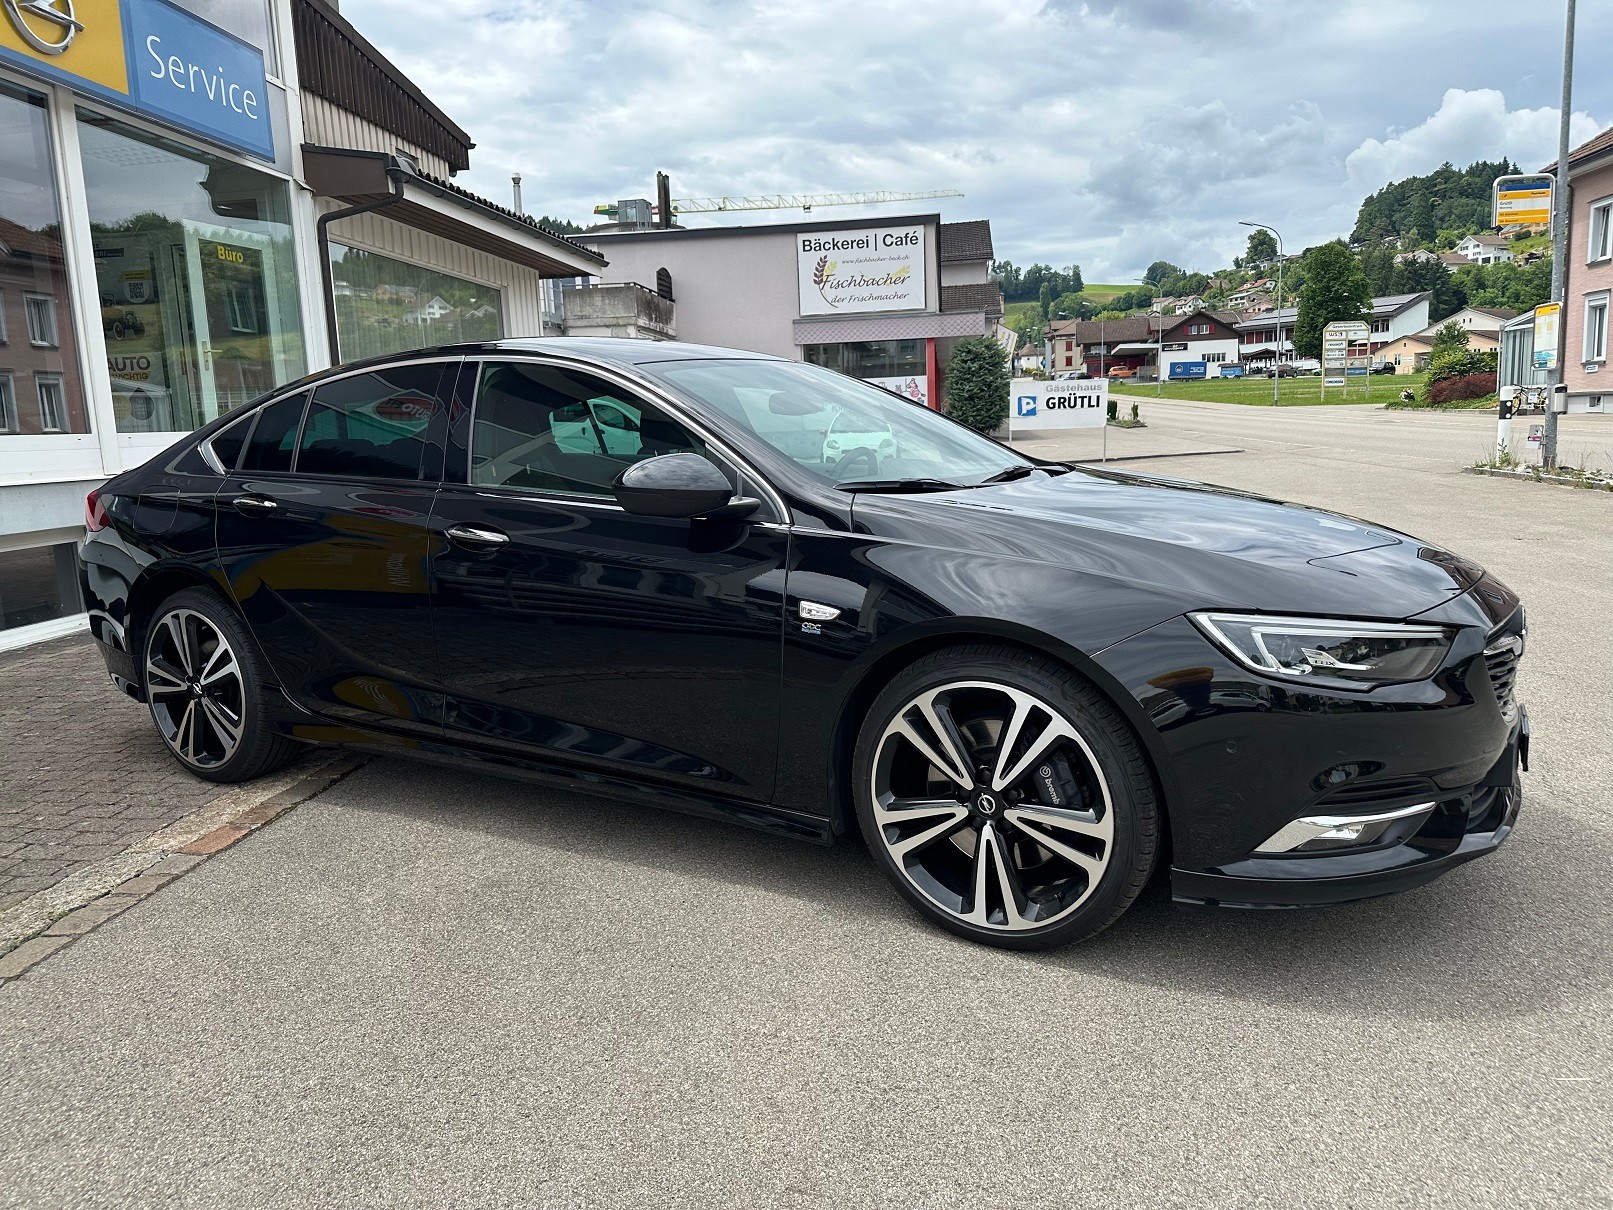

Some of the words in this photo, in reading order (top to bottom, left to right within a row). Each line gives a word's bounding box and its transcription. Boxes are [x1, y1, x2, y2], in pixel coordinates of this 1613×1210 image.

[146, 35, 258, 120] Service
[802, 235, 870, 252] Bäckerei
[882, 230, 919, 247] Café
[217, 245, 244, 263] Büro
[820, 272, 911, 291] Fischbacher
[830, 293, 848, 304] der
[847, 292, 910, 304] Frischmacher
[107, 355, 151, 372] AUTO
[1045, 382, 1103, 393] Gästehaus
[1045, 393, 1100, 410] GRÜTLI
[1044, 777, 1060, 805] bremb
